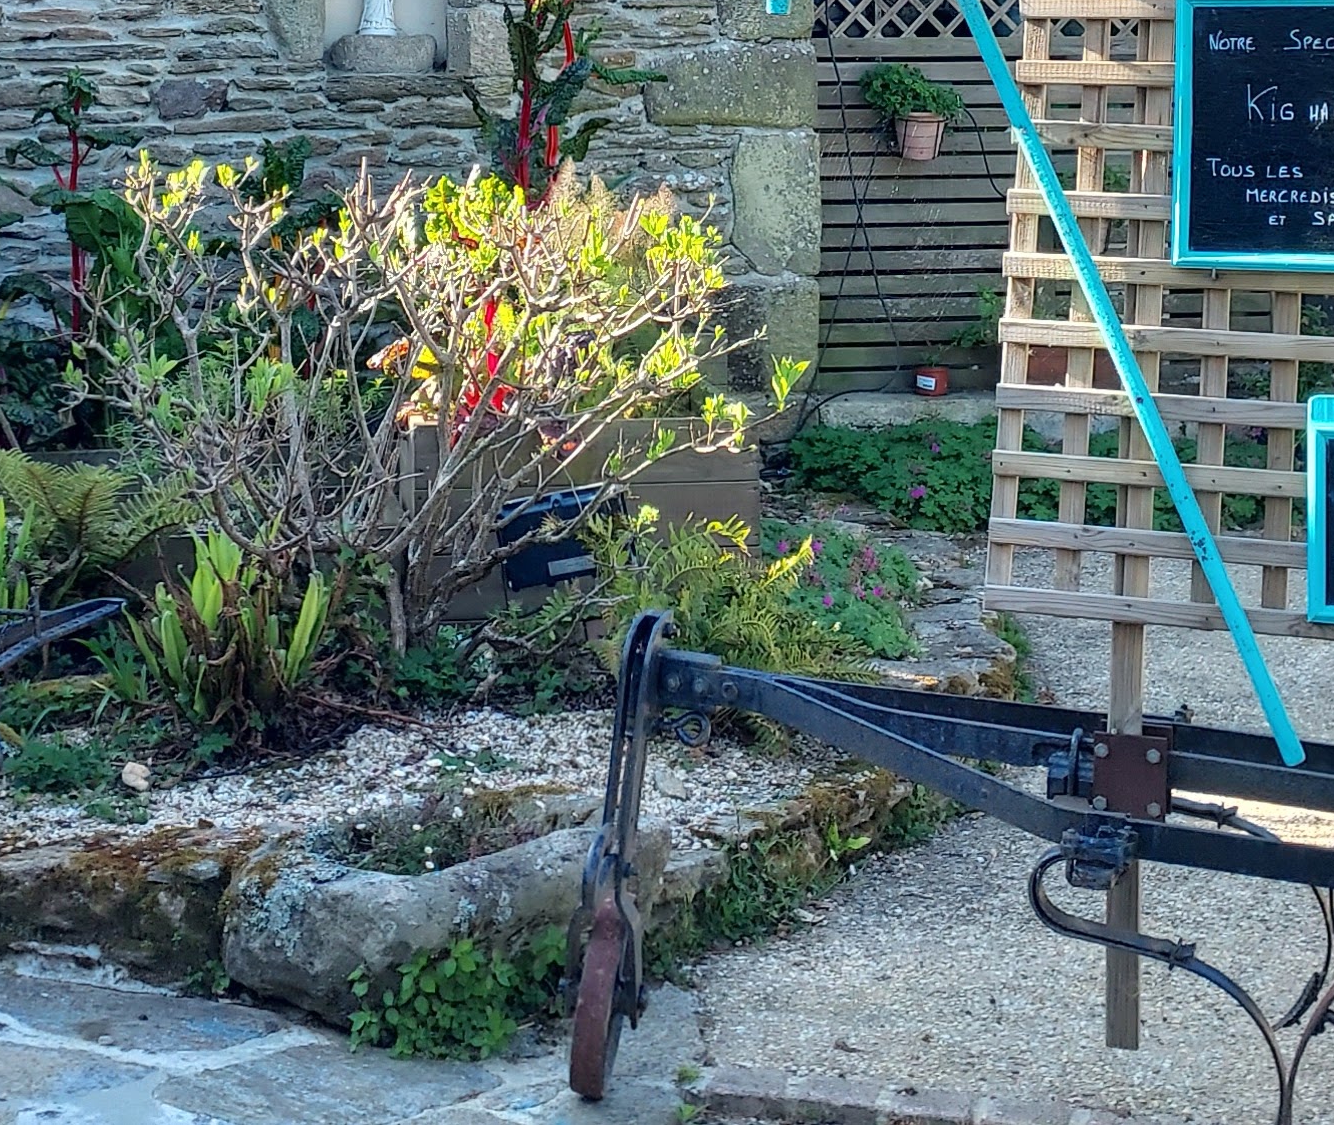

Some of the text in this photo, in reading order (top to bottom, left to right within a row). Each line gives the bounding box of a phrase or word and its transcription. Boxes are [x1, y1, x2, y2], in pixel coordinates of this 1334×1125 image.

[1209, 30, 1256, 52] NOTRE
[1206, 158, 1304, 179] TOUS LES
[1268, 215, 1287, 226] ET
